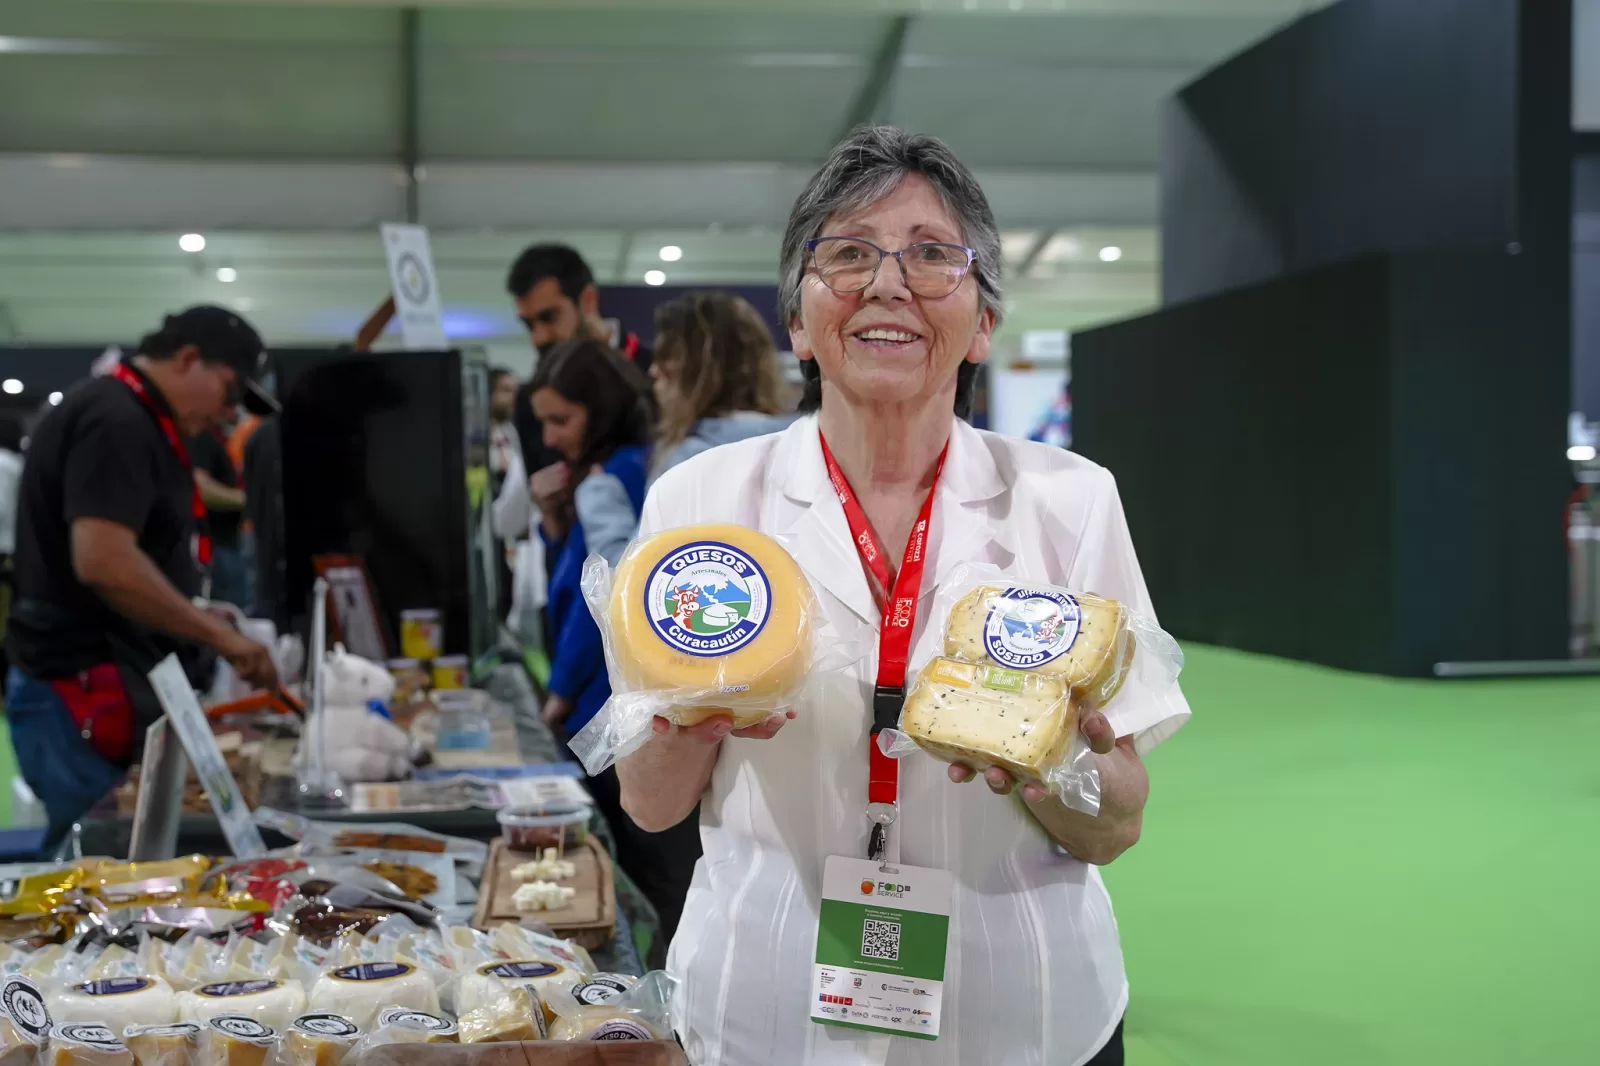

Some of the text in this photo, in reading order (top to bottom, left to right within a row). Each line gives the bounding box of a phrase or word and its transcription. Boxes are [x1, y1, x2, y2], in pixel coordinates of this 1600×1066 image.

[912, 532, 923, 562] carozzi
[671, 550, 747, 574] QUESOS
[690, 567, 728, 578] Artesanales
[891, 599, 903, 627] SERVICE
[898, 600, 913, 628] FOOD
[668, 625, 747, 649] Curacautín
[992, 639, 1045, 664] QUESOS
[877, 890, 904, 899] SERVICE
[878, 881, 905, 893] FOOD
